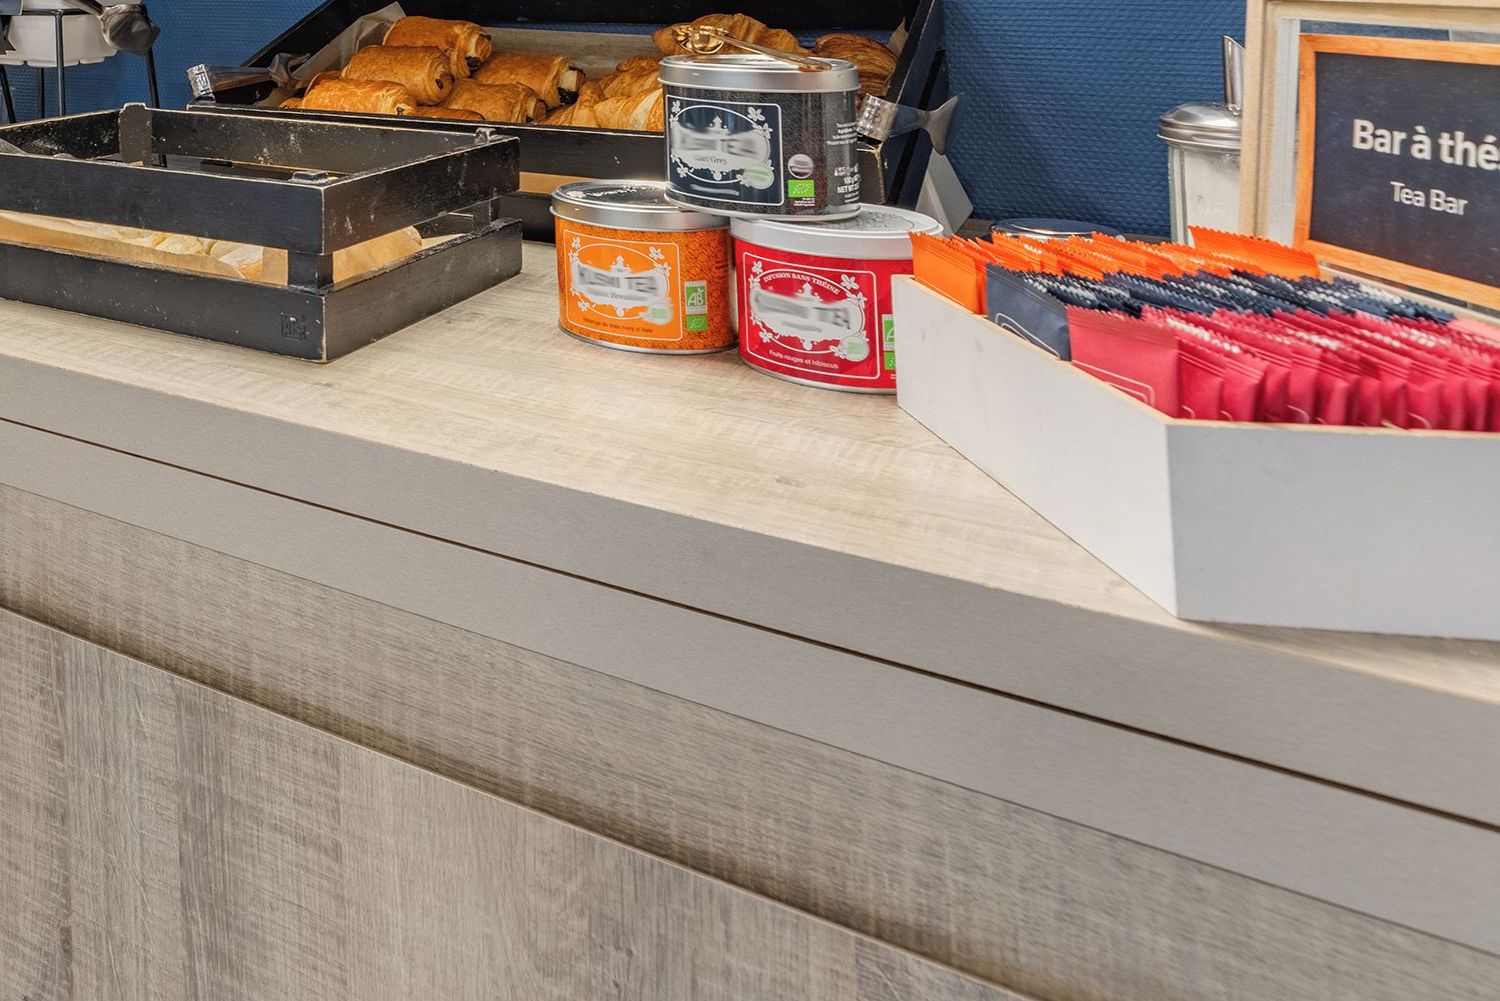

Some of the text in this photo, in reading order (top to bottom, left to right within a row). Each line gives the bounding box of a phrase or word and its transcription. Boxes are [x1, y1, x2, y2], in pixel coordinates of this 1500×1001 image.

[1352, 118, 1500, 171] Bar à thé
[1390, 181, 1469, 216] Tea Bar
[763, 271, 841, 295] INFUSION SANS THÉINE
[768, 349, 784, 359] Fruits
[784, 354, 804, 364] rouges
[811, 359, 839, 369] hibiscus
